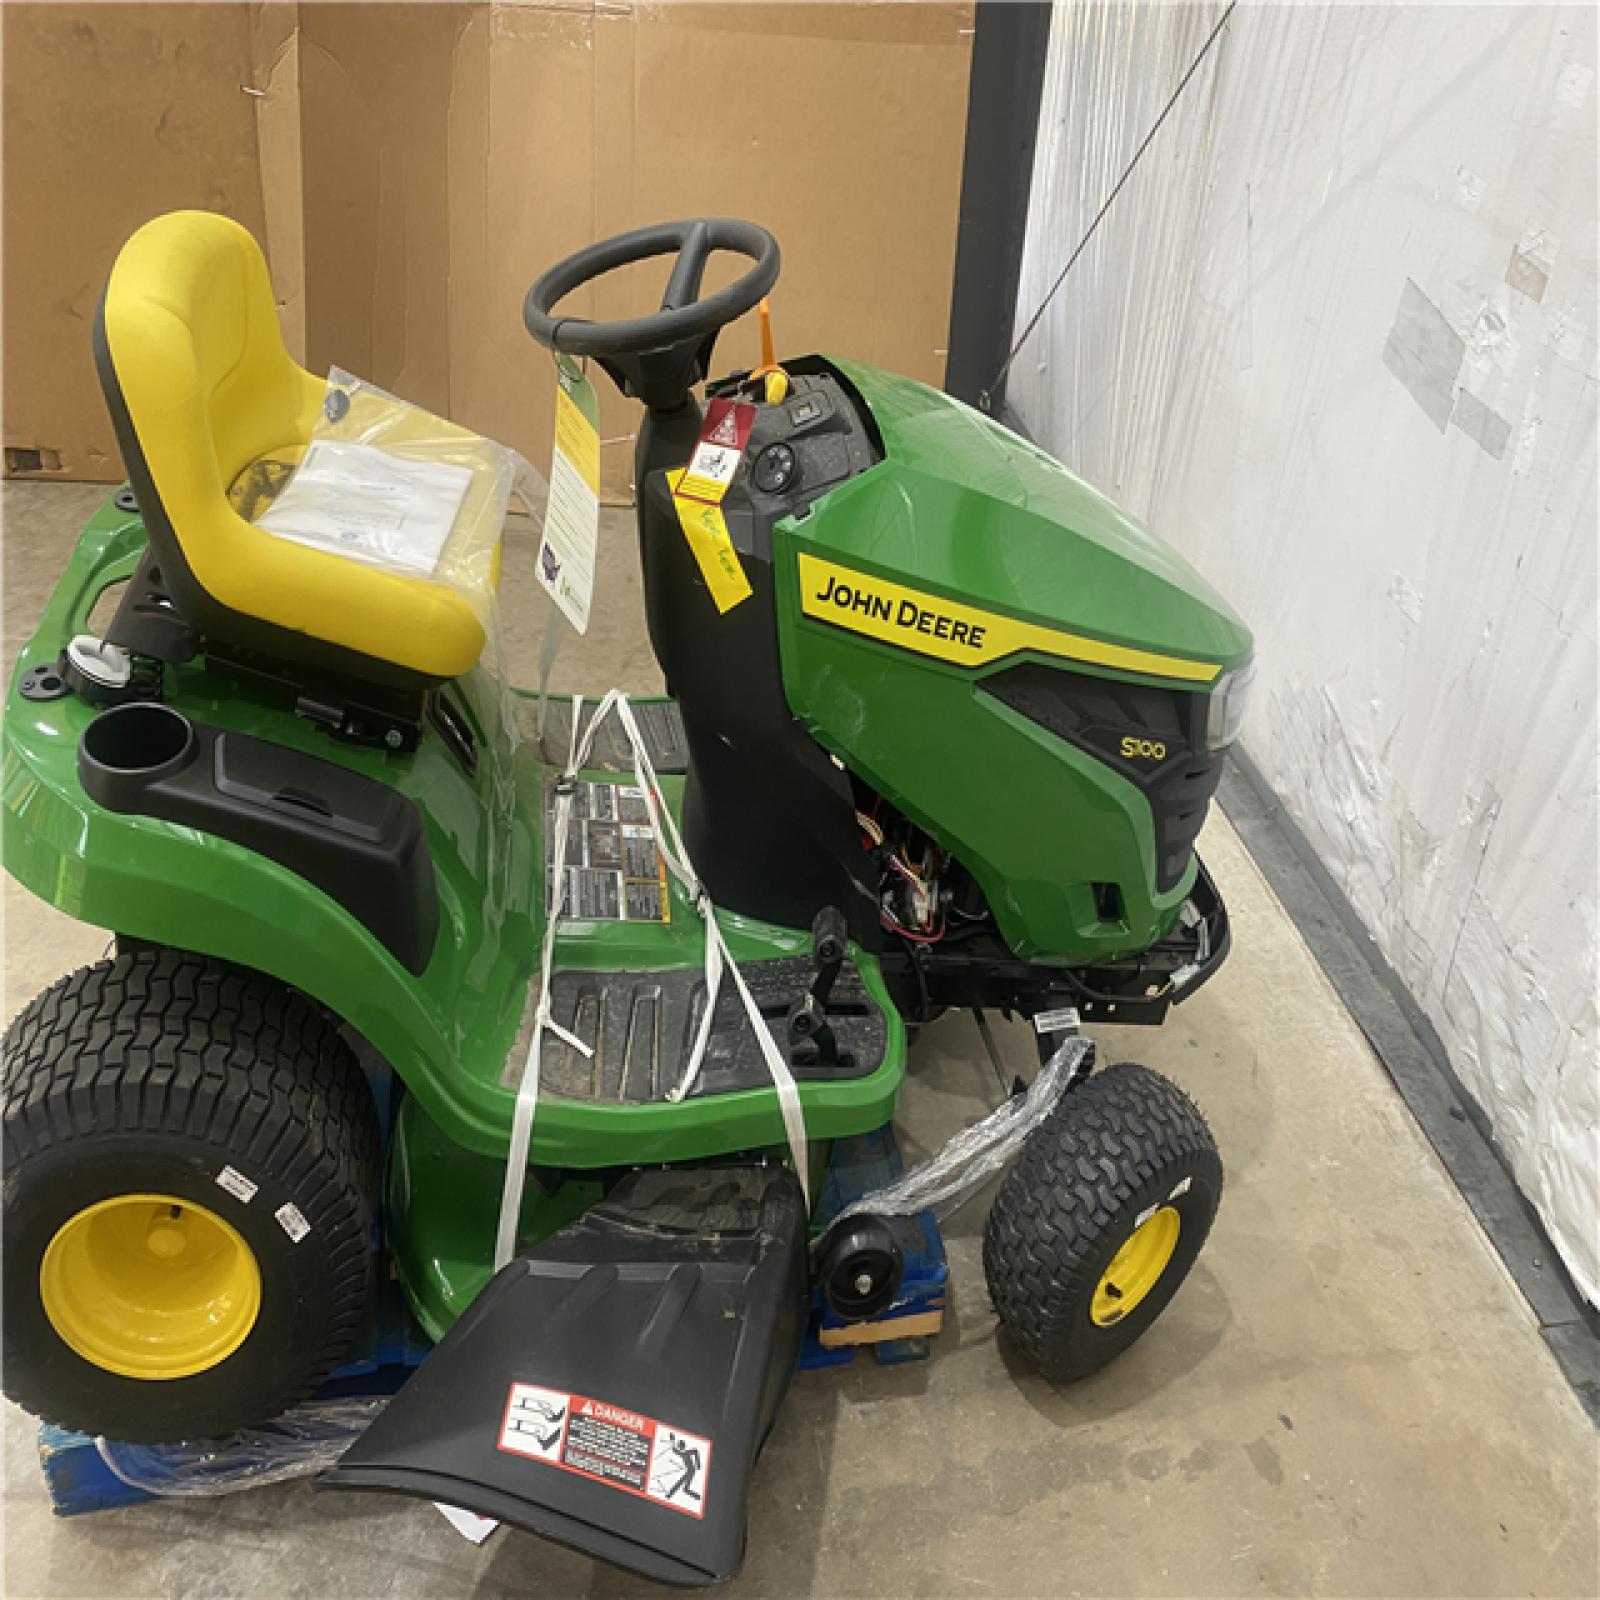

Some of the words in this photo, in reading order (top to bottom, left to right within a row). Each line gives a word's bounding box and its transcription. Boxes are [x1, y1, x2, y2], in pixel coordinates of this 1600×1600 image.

[816, 576, 893, 622] JOHN
[896, 600, 987, 649] DEERE
[1120, 736, 1167, 761] S100
[594, 1403, 645, 1432] DANGER
